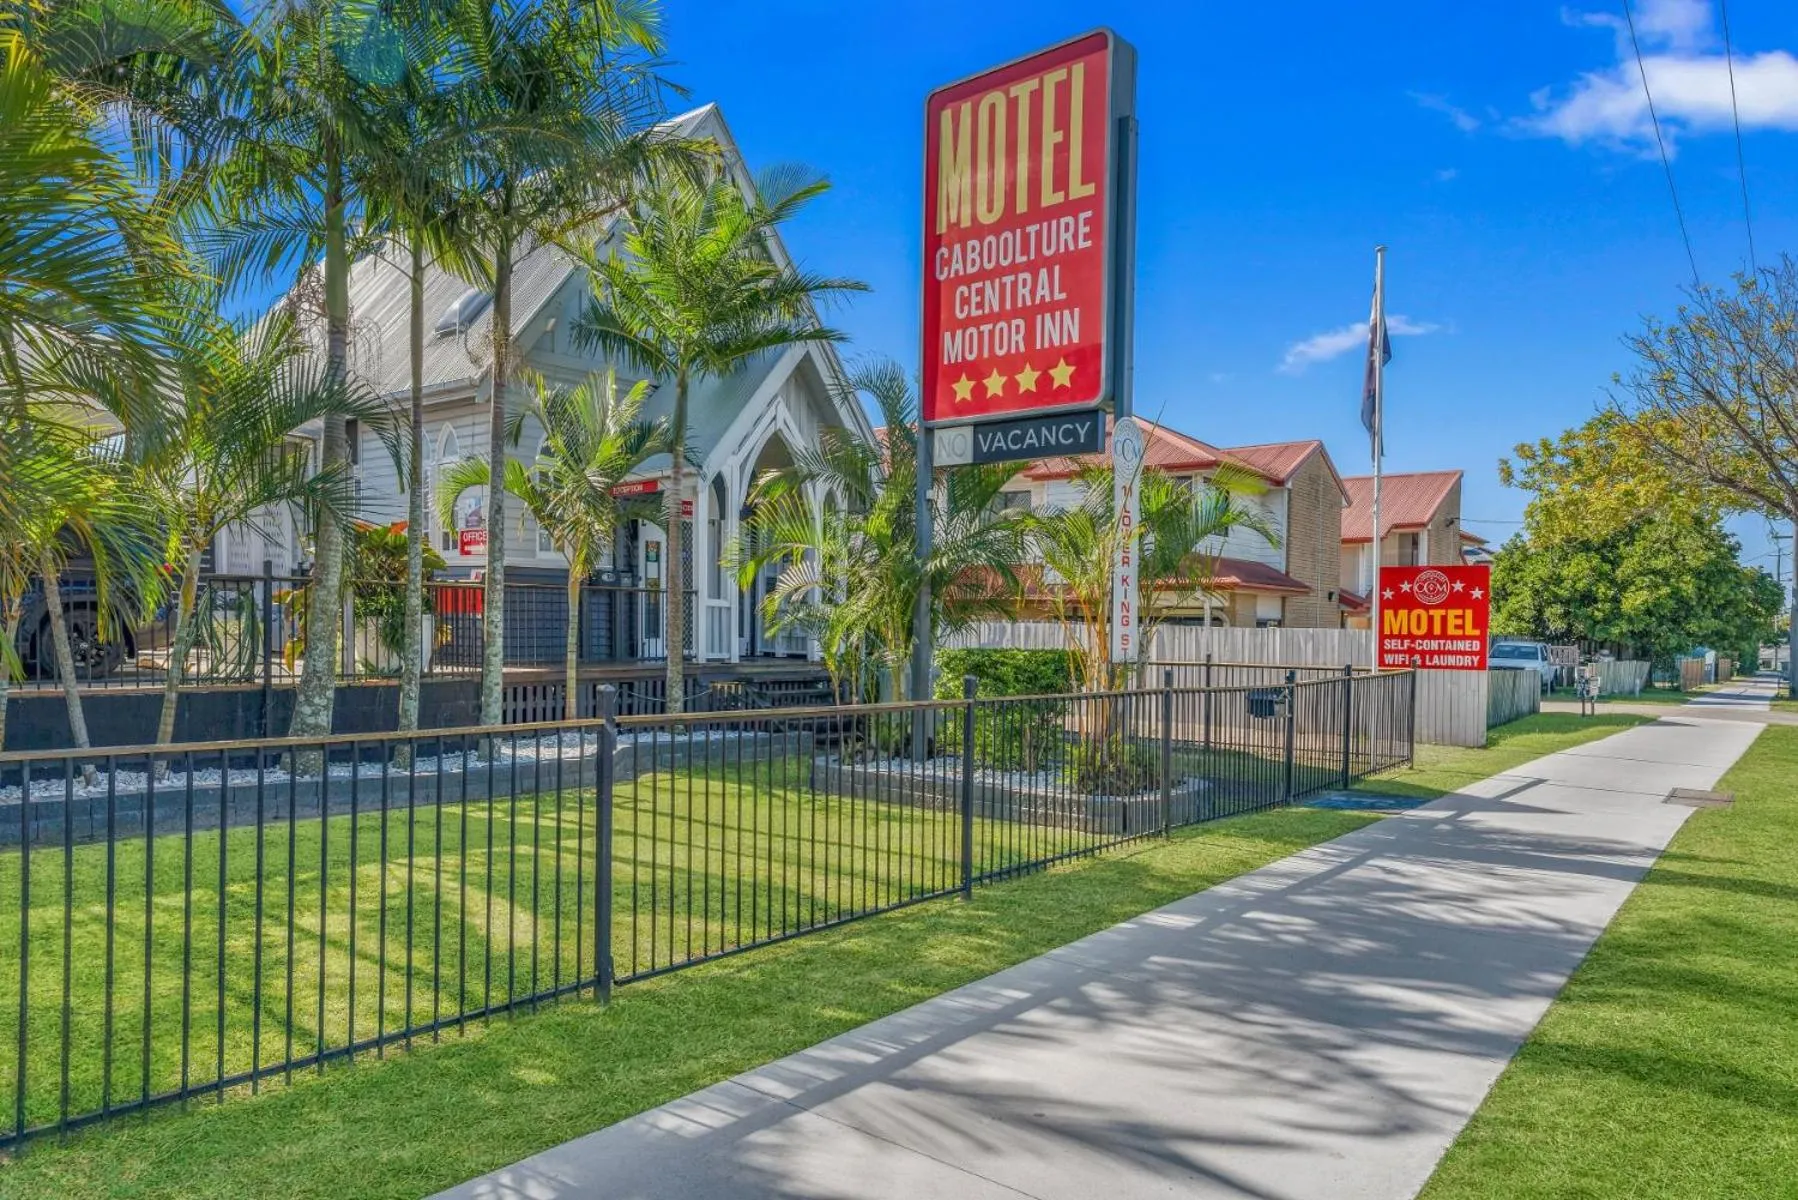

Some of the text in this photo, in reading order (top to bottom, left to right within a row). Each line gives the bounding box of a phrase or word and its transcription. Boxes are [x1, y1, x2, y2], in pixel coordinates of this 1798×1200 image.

[936, 62, 1096, 235] MOTEL
[935, 210, 1094, 281] CABOOLTURE
[954, 265, 1067, 320] CENTRAL
[943, 308, 1080, 365] MOTOR INN
[937, 433, 968, 458] NO
[978, 421, 1091, 453] VACANCY
[463, 531, 488, 542] OFFICE
[1121, 575, 1130, 627] KING
[1383, 609, 1481, 636] MOTEL
[1383, 639, 1480, 652] SELF-CONTAINED
[1383, 653, 1410, 665] WIFI
[1425, 654, 1480, 667] LAUNDRY
